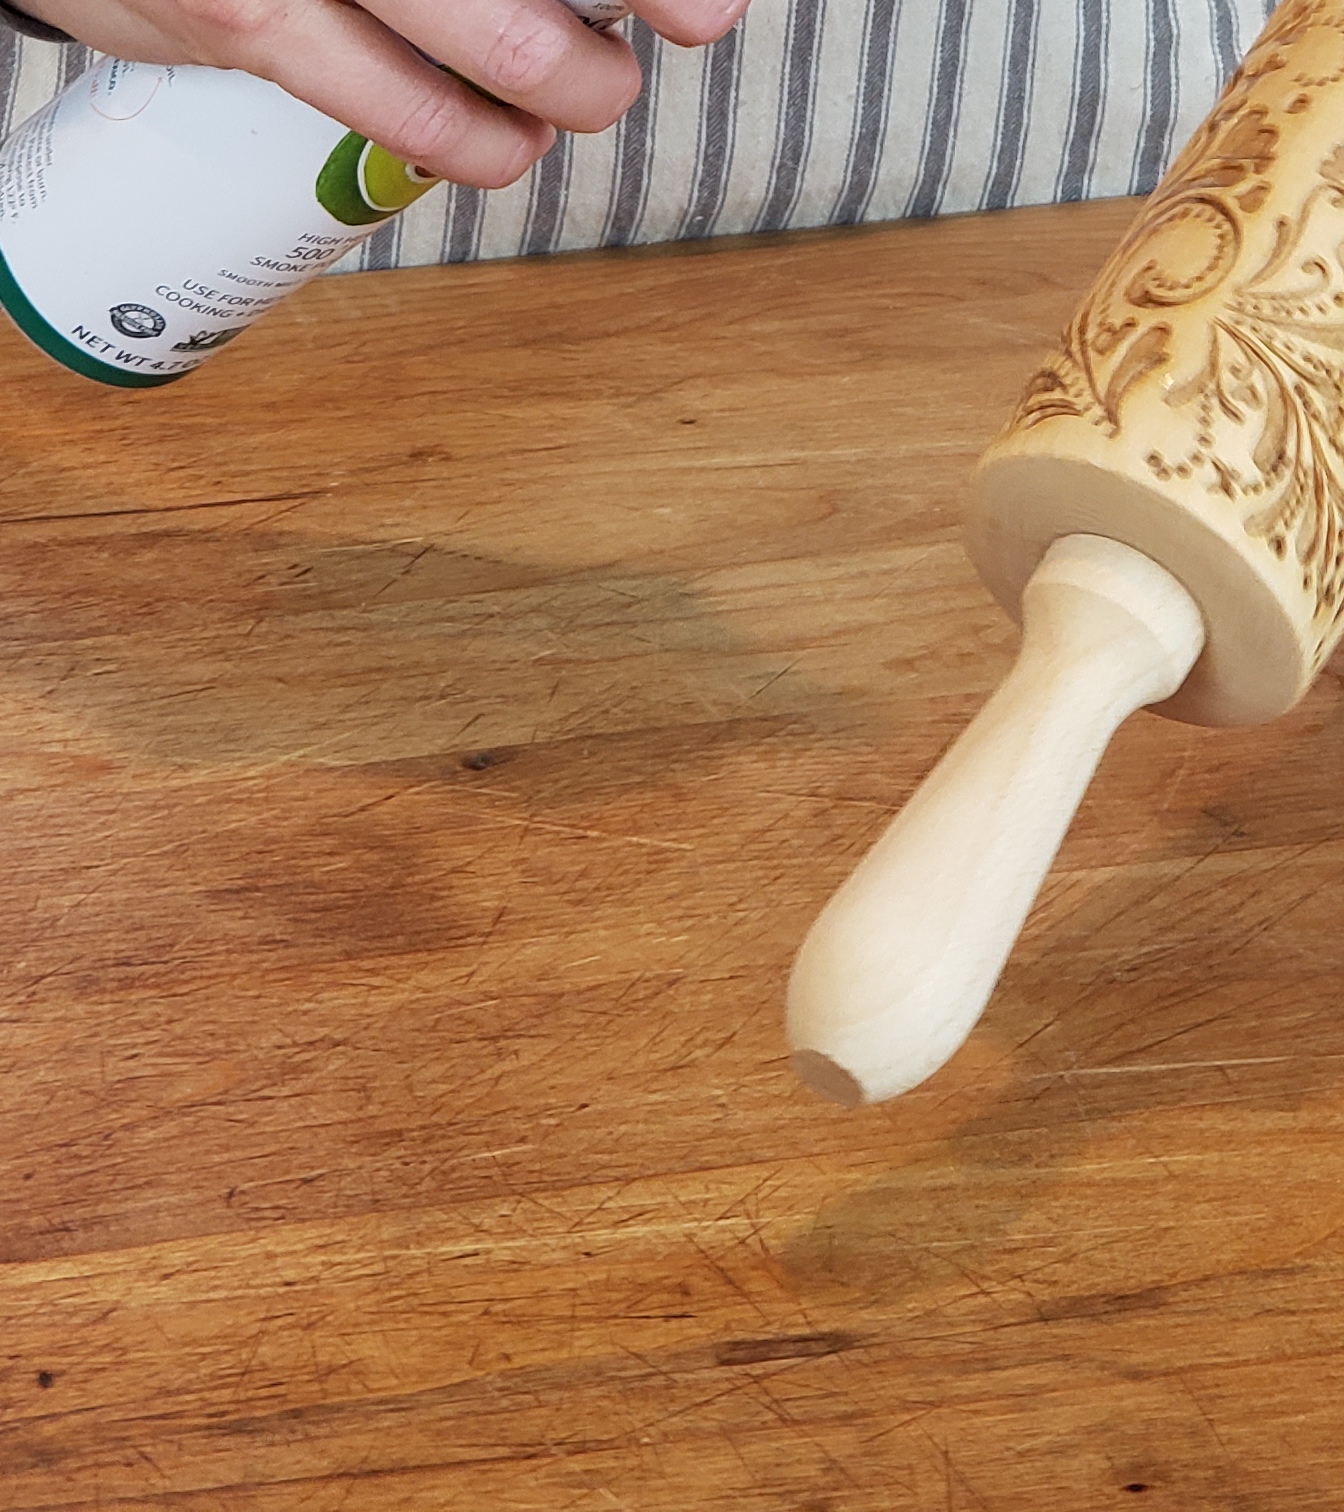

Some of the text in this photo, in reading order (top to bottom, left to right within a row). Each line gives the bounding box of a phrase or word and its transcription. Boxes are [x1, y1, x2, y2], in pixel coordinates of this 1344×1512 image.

[297, 232, 343, 246] HIGH
[285, 246, 335, 260] 500
[250, 256, 310, 273] SMOKE
[217, 269, 274, 288] SMOOTH
[155, 285, 238, 319] COOKING
[182, 278, 220, 300] USE
[217, 294, 254, 307] FOR
[71, 324, 116, 354] NET
[115, 349, 152, 367] WT
